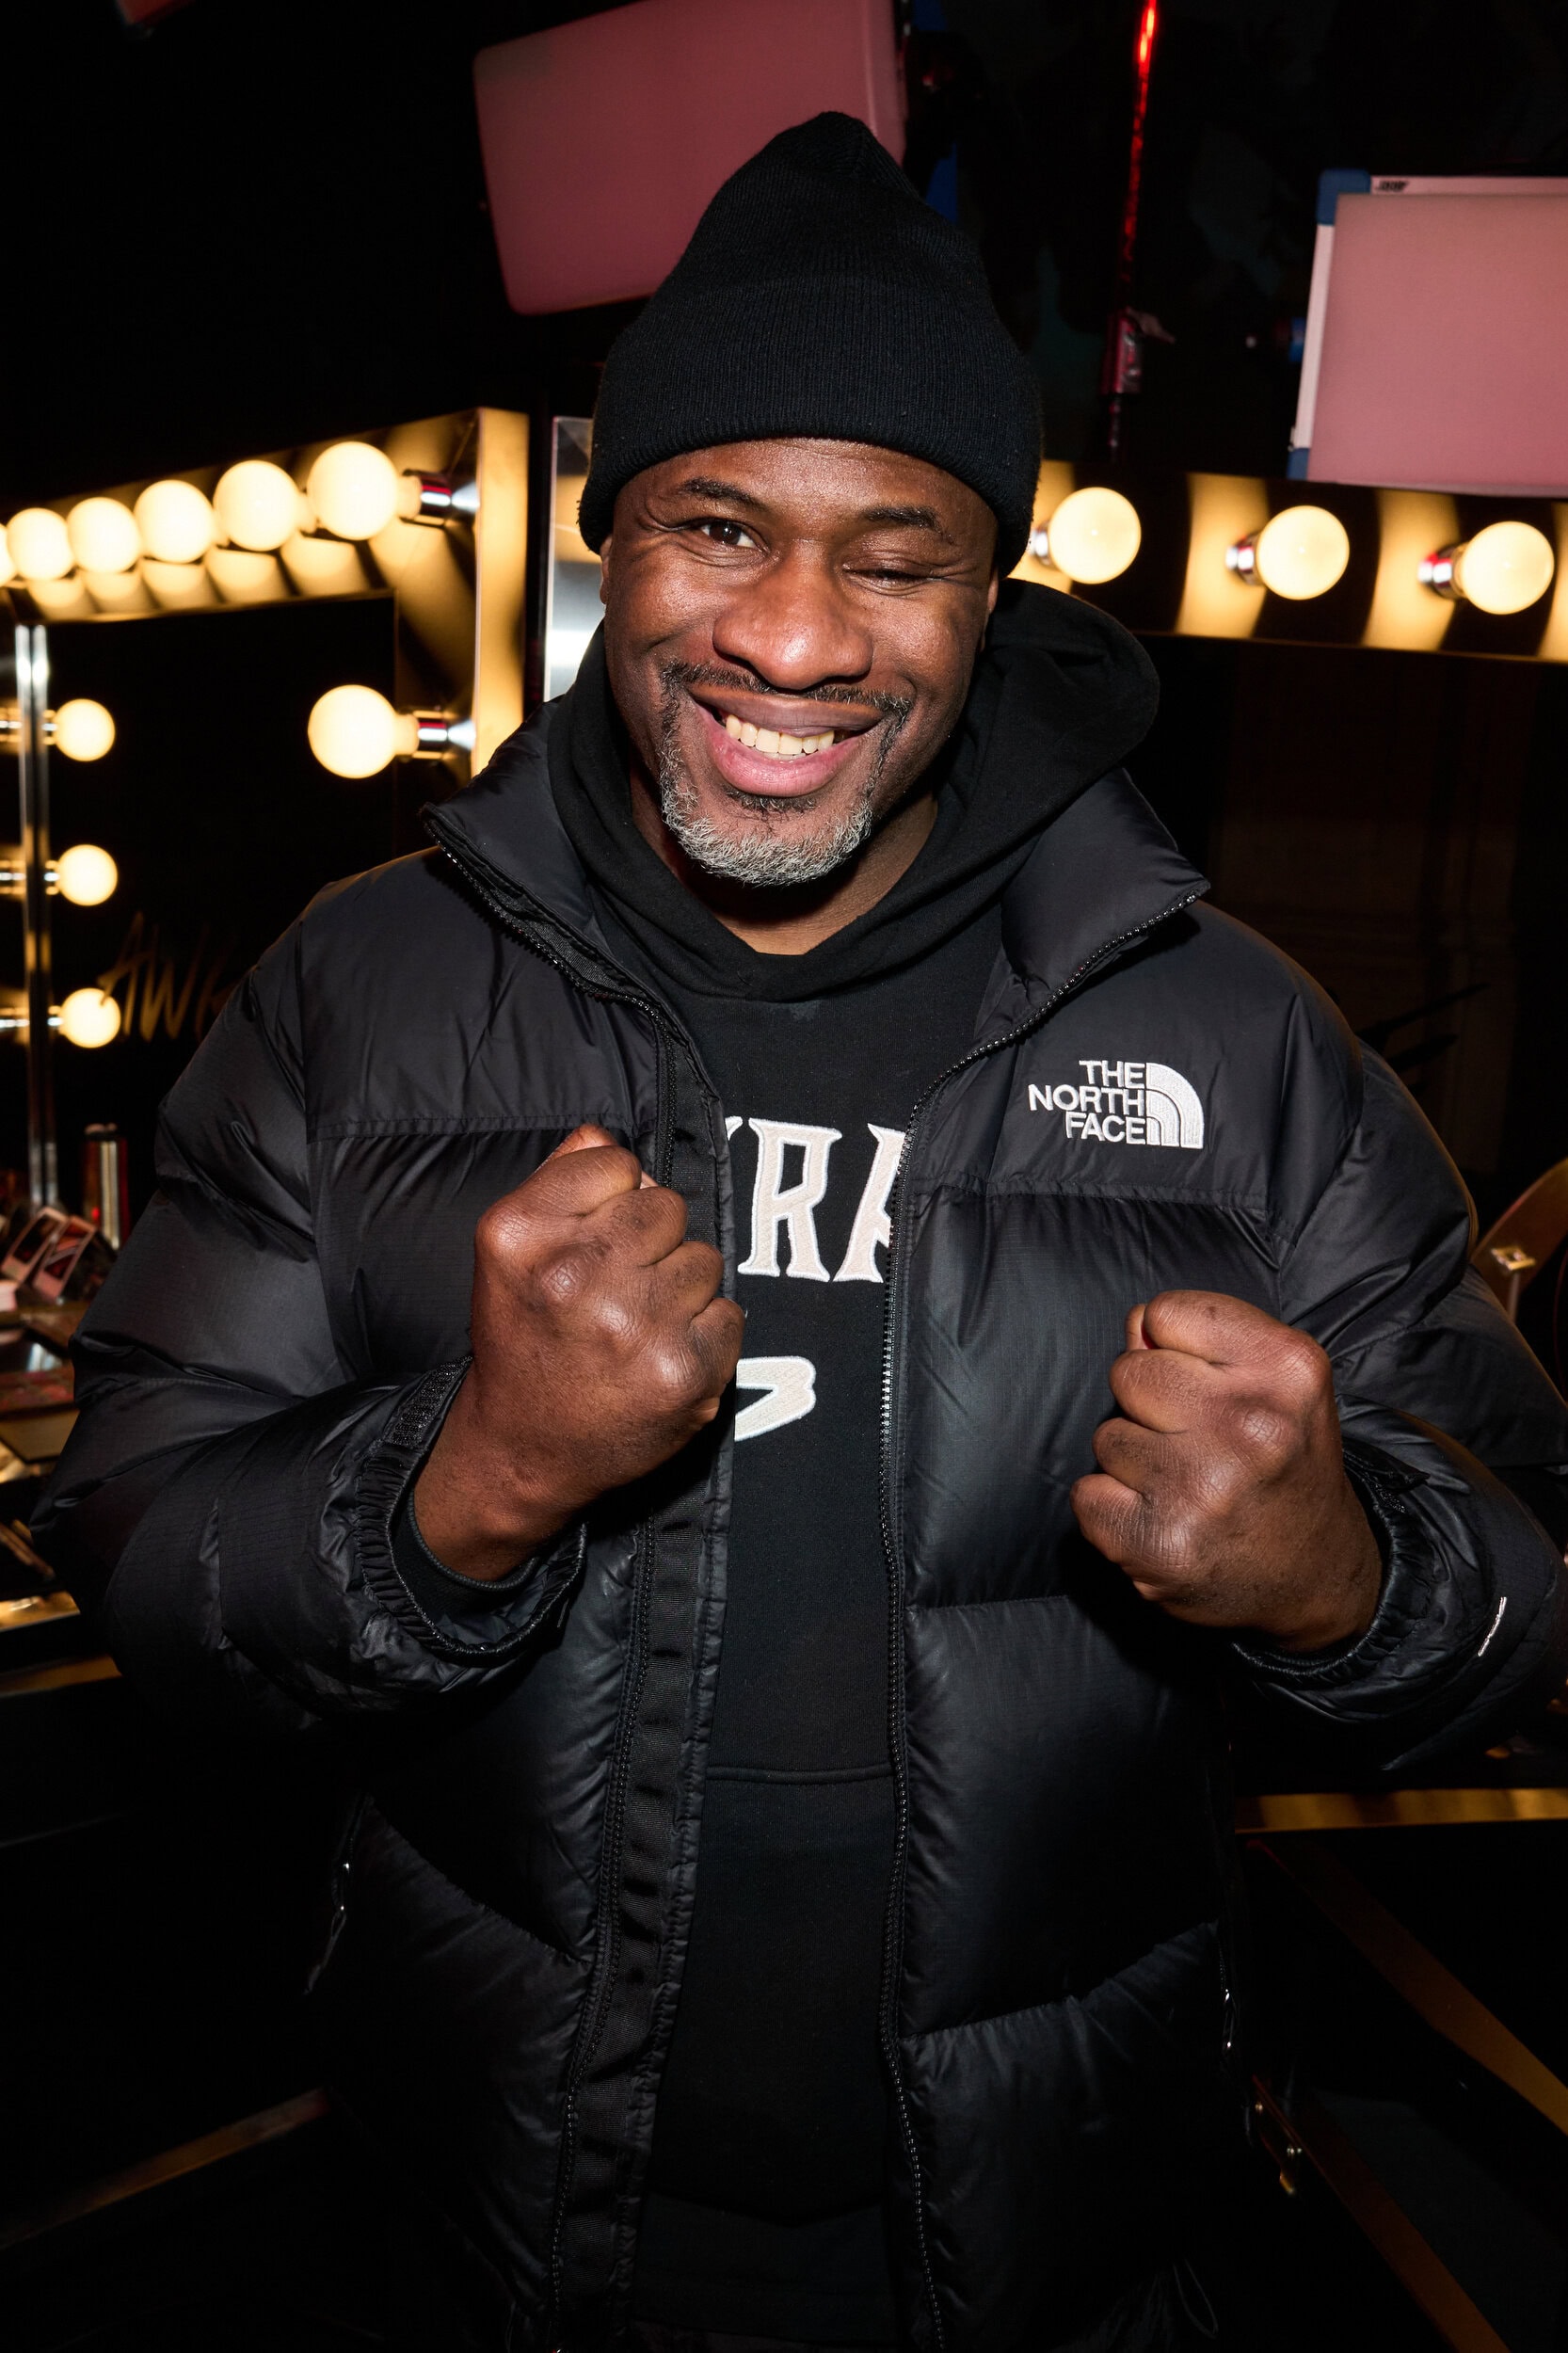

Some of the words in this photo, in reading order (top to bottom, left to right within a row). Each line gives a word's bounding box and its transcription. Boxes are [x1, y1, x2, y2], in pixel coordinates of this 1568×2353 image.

[1079, 1060, 1145, 1089] THE
[1028, 1083, 1144, 1116] NORTH
[1065, 1111, 1146, 1145] FACE
